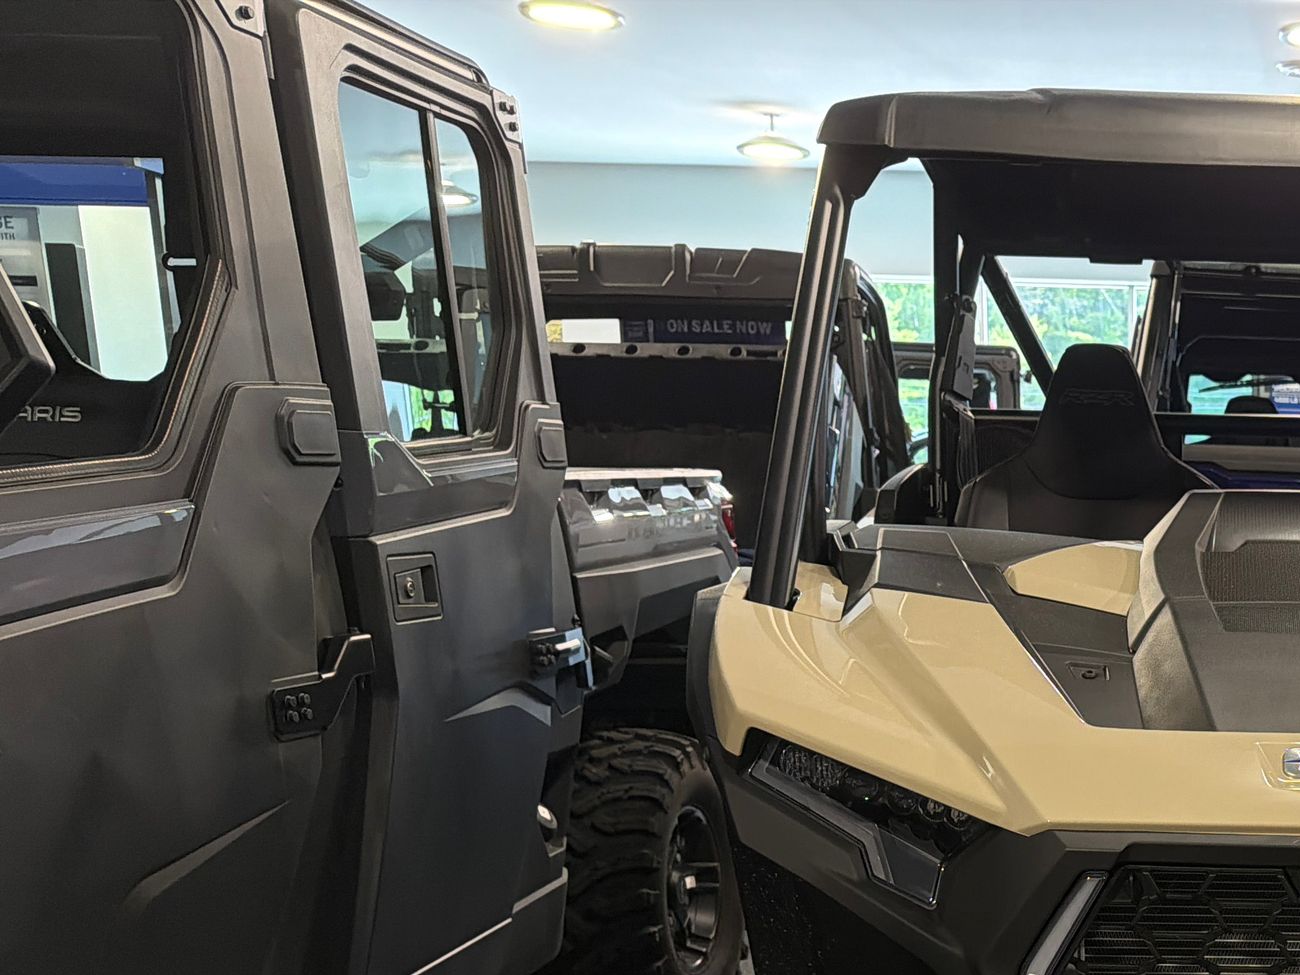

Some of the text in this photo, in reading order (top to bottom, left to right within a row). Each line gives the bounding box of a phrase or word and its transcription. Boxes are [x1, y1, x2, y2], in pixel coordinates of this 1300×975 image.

[667, 319, 772, 335] ON SALE NOW
